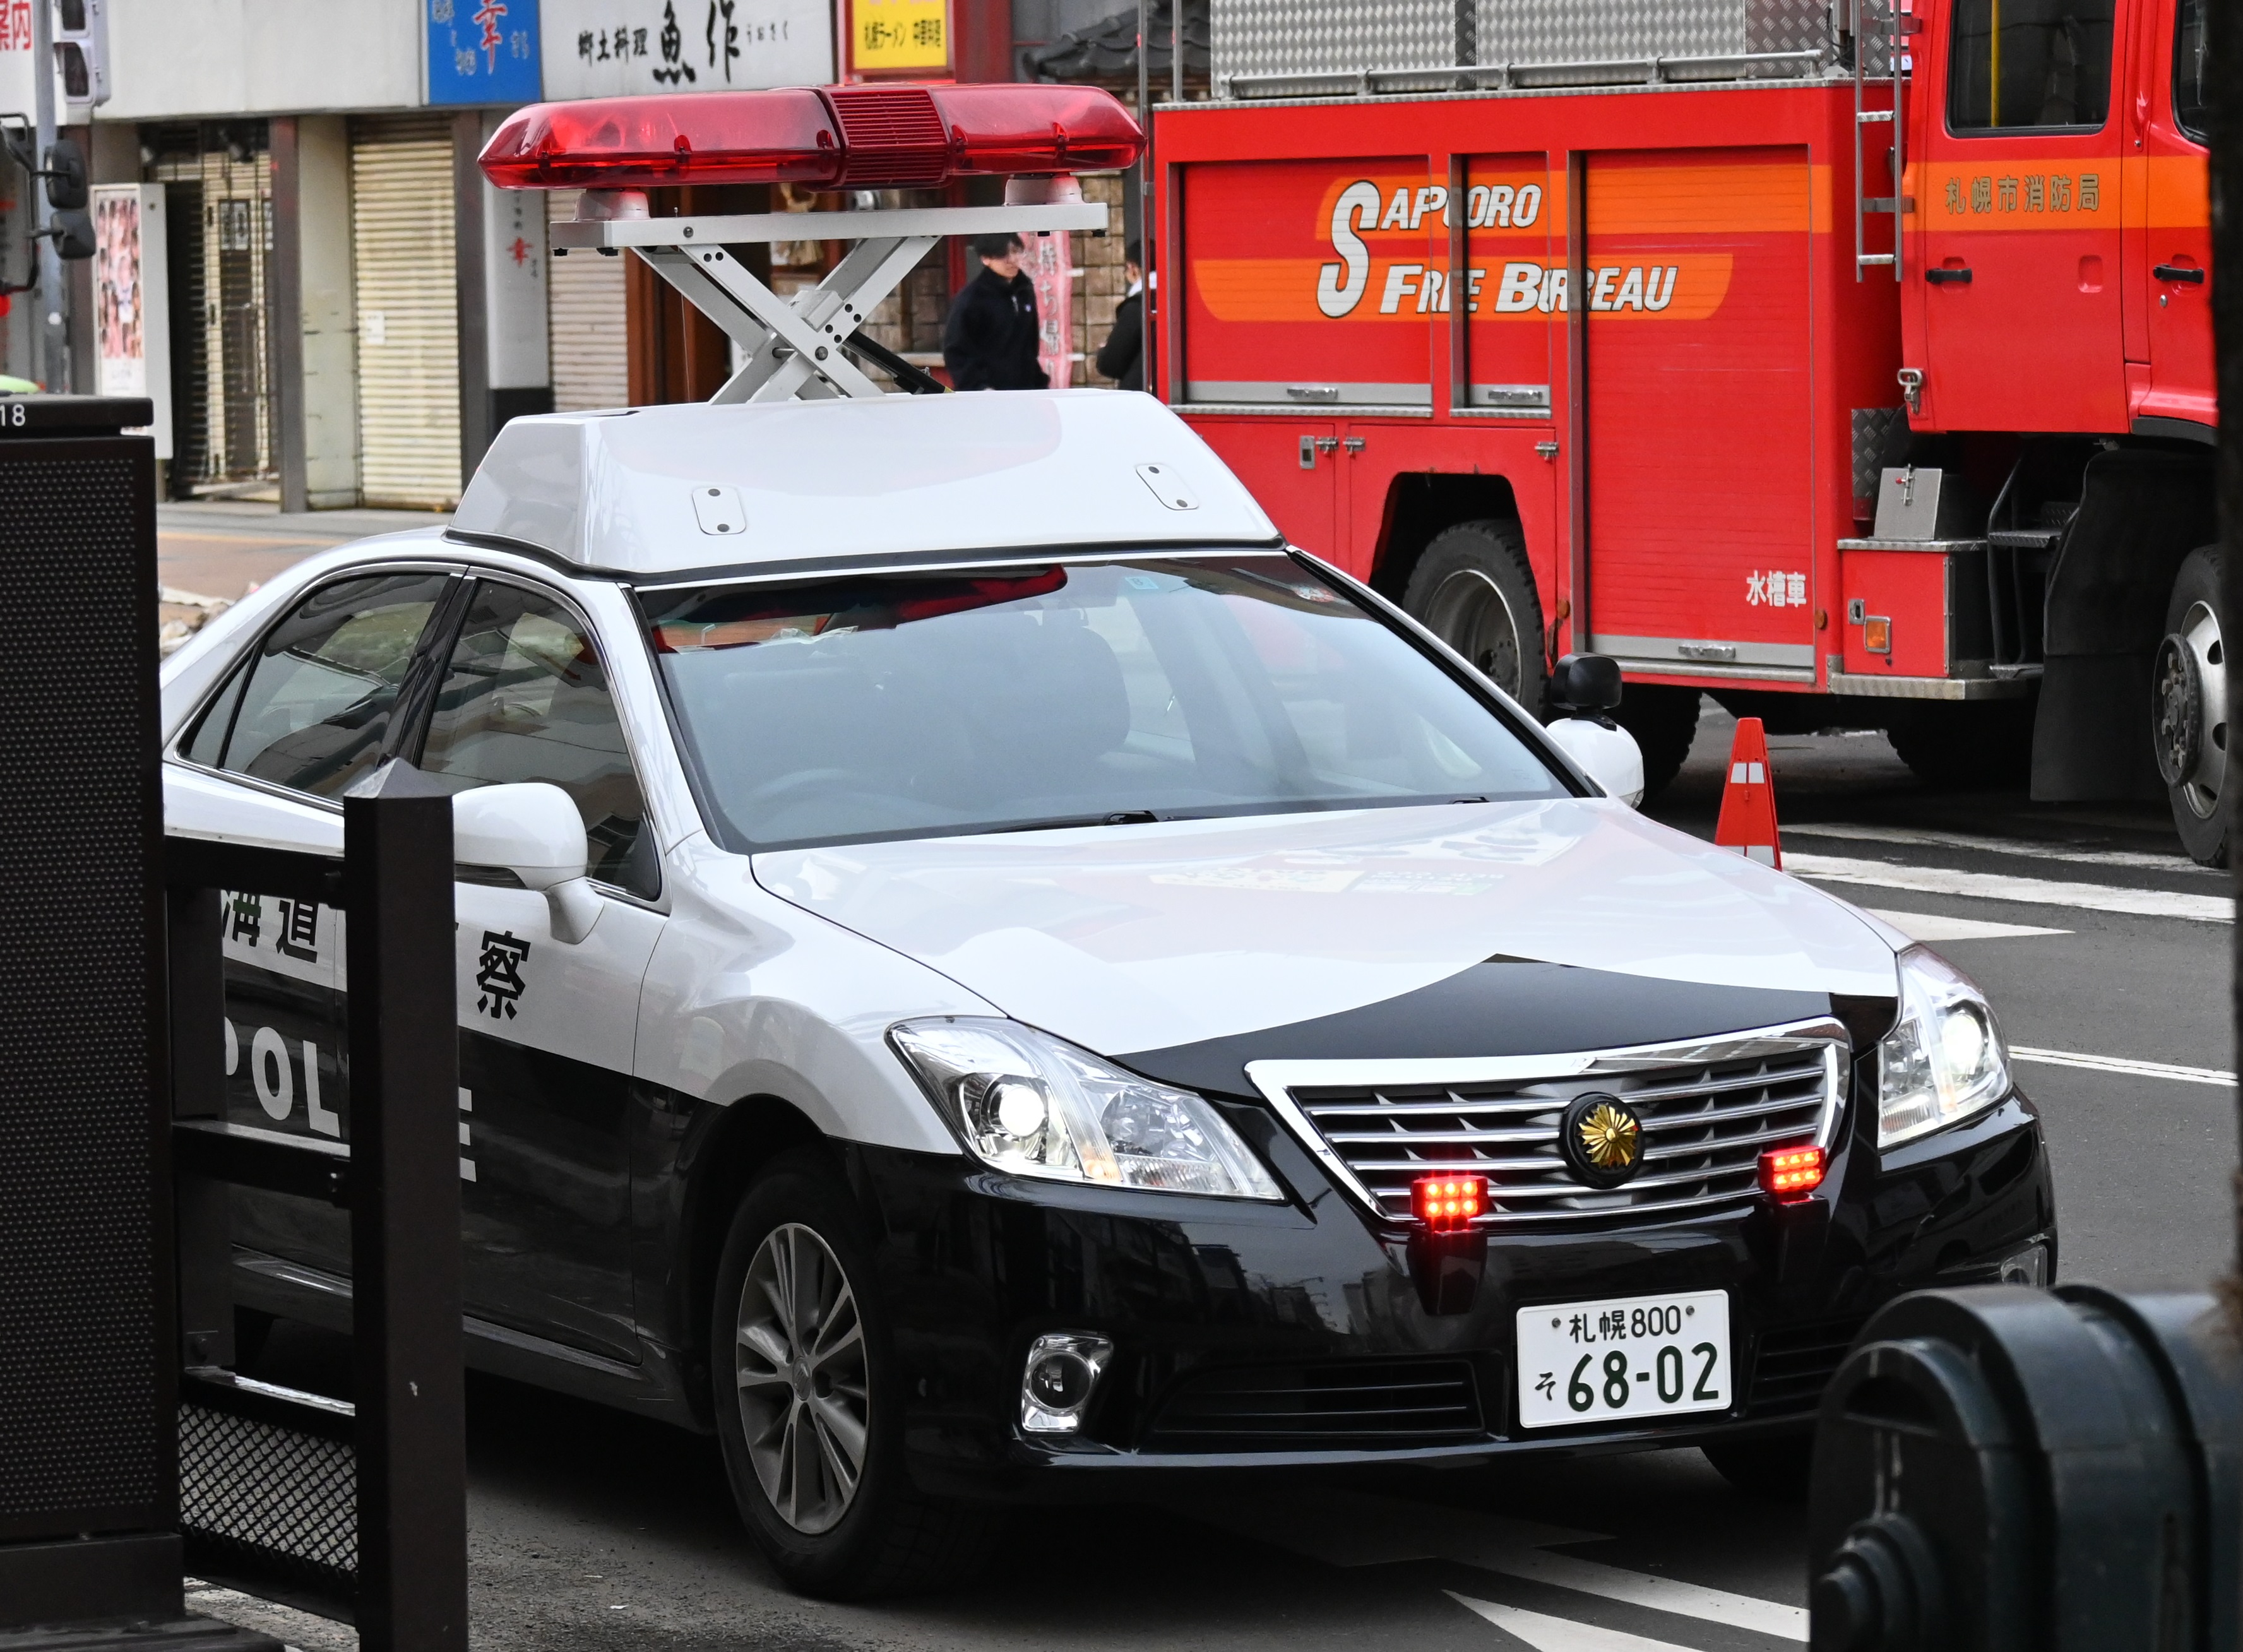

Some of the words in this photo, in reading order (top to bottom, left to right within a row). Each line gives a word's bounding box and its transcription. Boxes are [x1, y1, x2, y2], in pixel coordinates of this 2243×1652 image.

[1944, 174, 2100, 215] 札幌市消防局
[0, 403, 27, 427] 18
[1746, 569, 1807, 608] 水槽車
[456, 922, 531, 1021] 察
[1535, 1371, 1557, 1401] そ
[1568, 1341, 1719, 1412] 68-02
